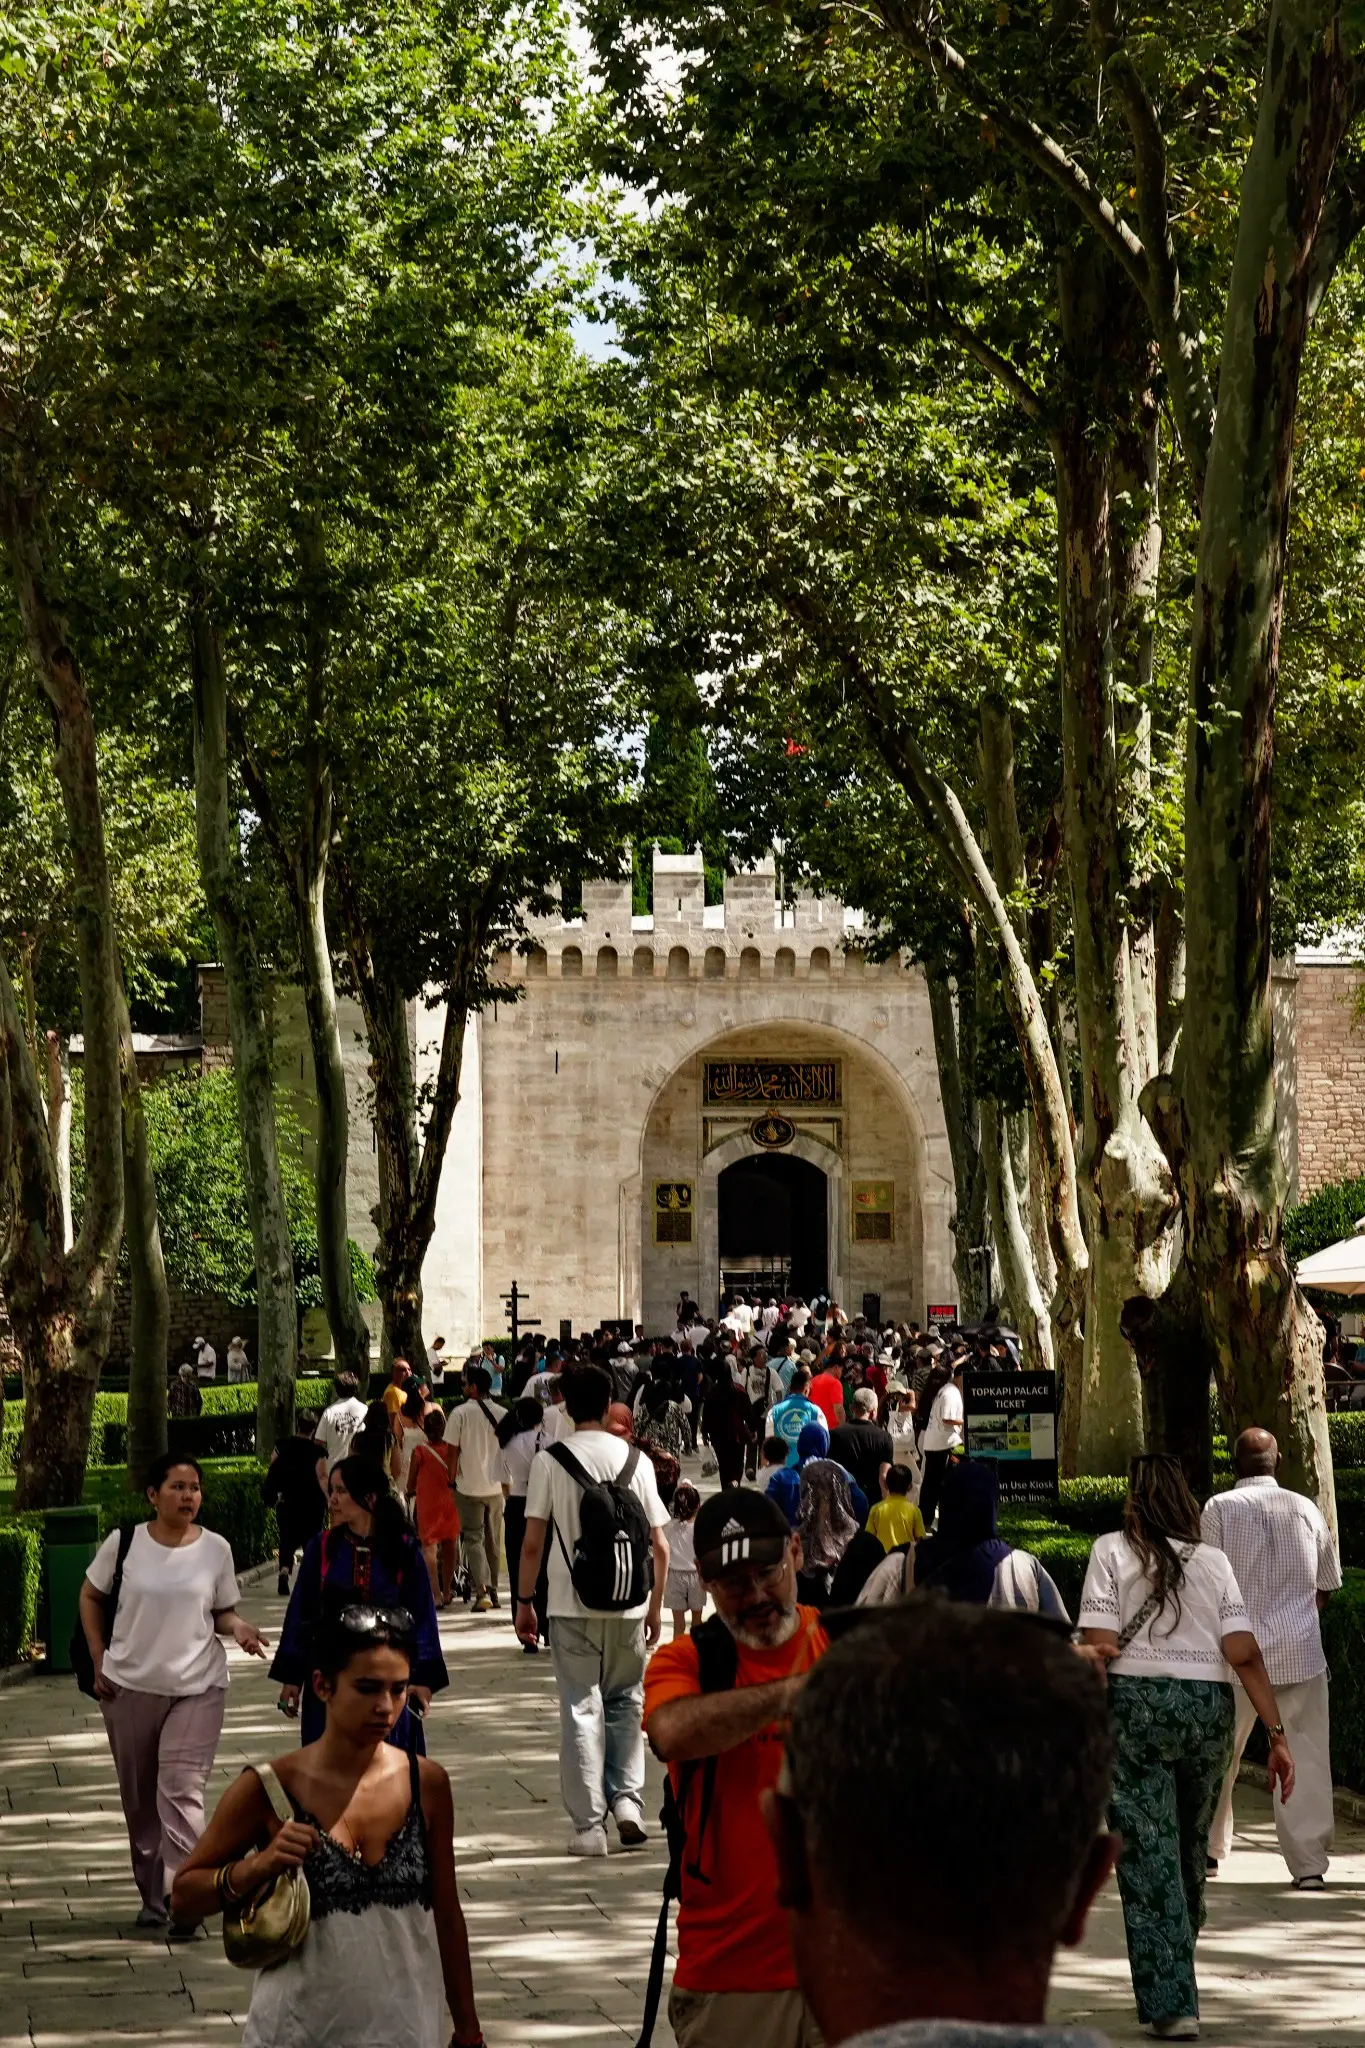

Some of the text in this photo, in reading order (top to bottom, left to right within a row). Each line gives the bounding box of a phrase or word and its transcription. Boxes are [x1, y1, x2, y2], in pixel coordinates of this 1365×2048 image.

[971, 1386, 1049, 1397] TOPKAPI PALACE
[995, 1400, 1026, 1409] TICKET
[1010, 1480, 1028, 1490] Use
[1029, 1480, 1054, 1490] Kiosk
[1011, 1493, 1027, 1503] the
